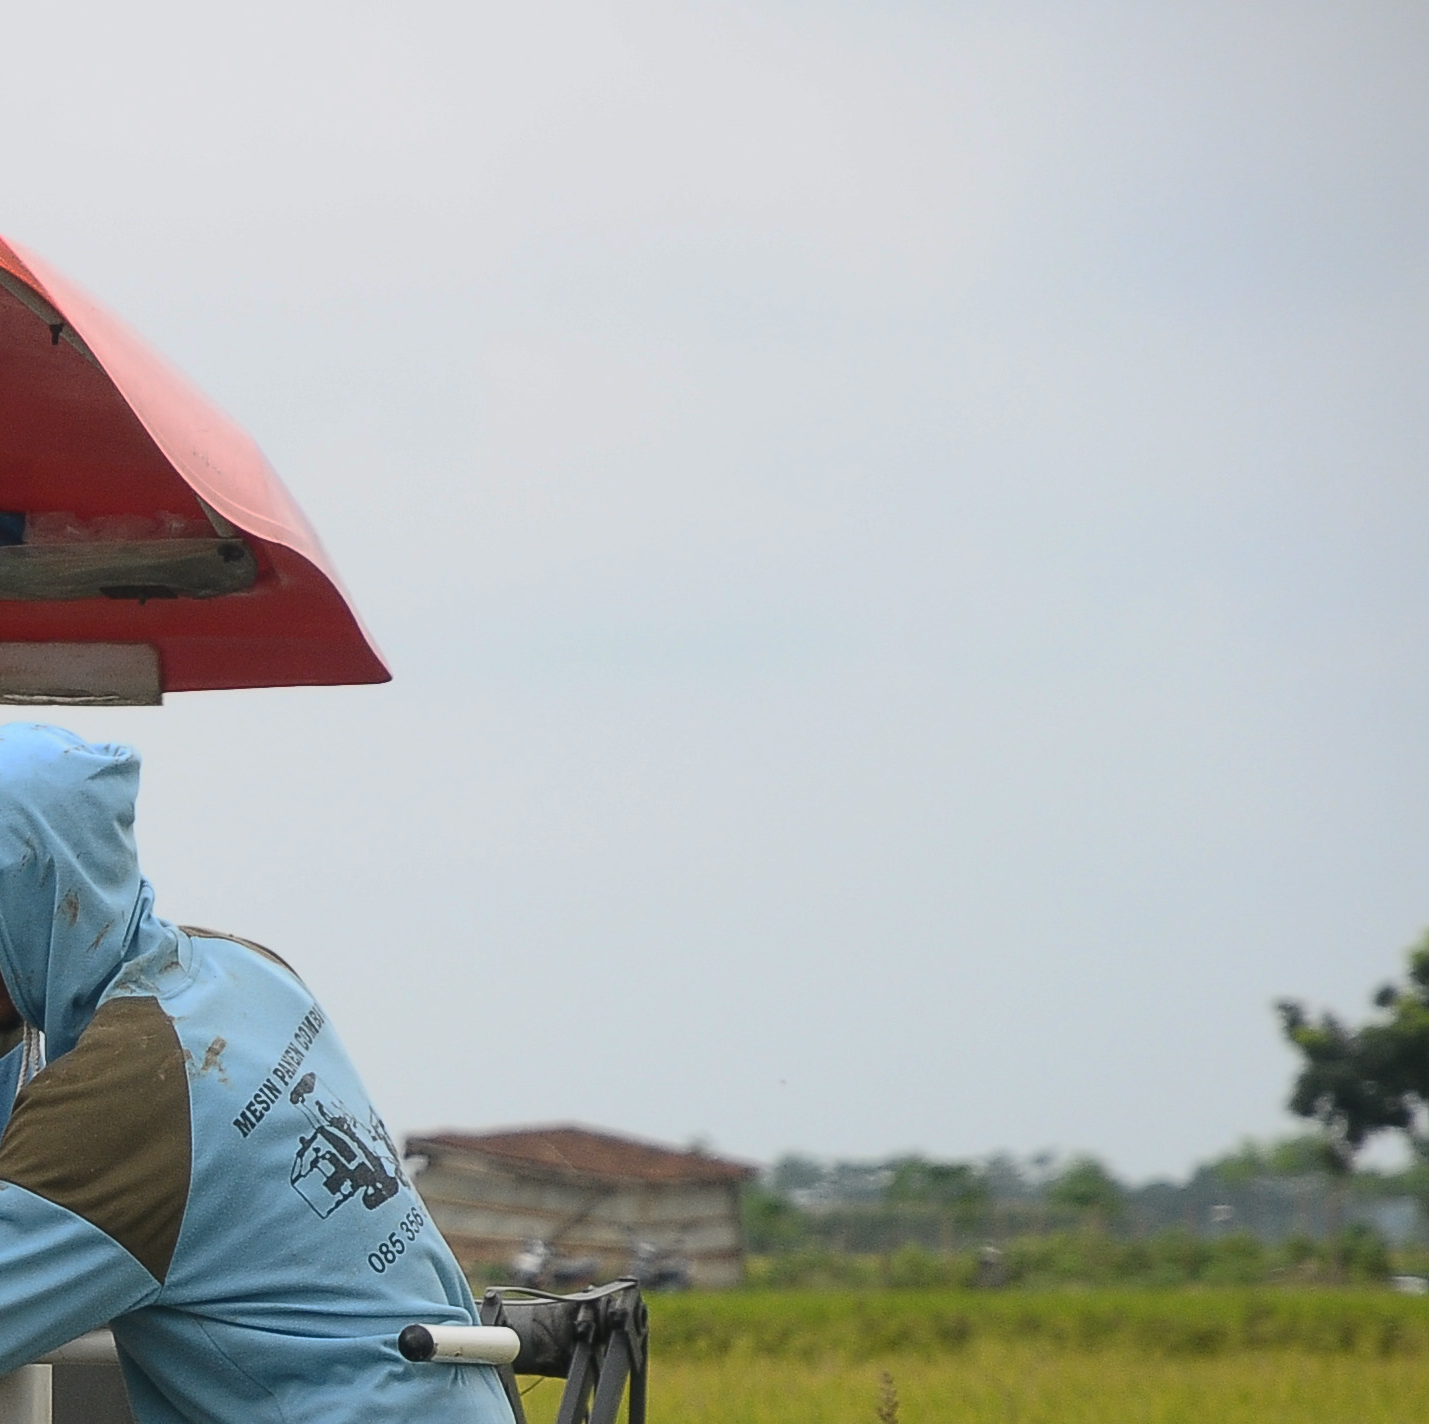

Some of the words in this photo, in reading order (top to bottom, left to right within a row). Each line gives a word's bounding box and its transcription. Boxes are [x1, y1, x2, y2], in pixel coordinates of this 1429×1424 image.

[232, 1077, 282, 1138] MESIN
[272, 1041, 305, 1087] PANEN
[293, 1002, 325, 1052] COMBI
[367, 1231, 406, 1274] 085
[399, 1206, 424, 1242] 356
